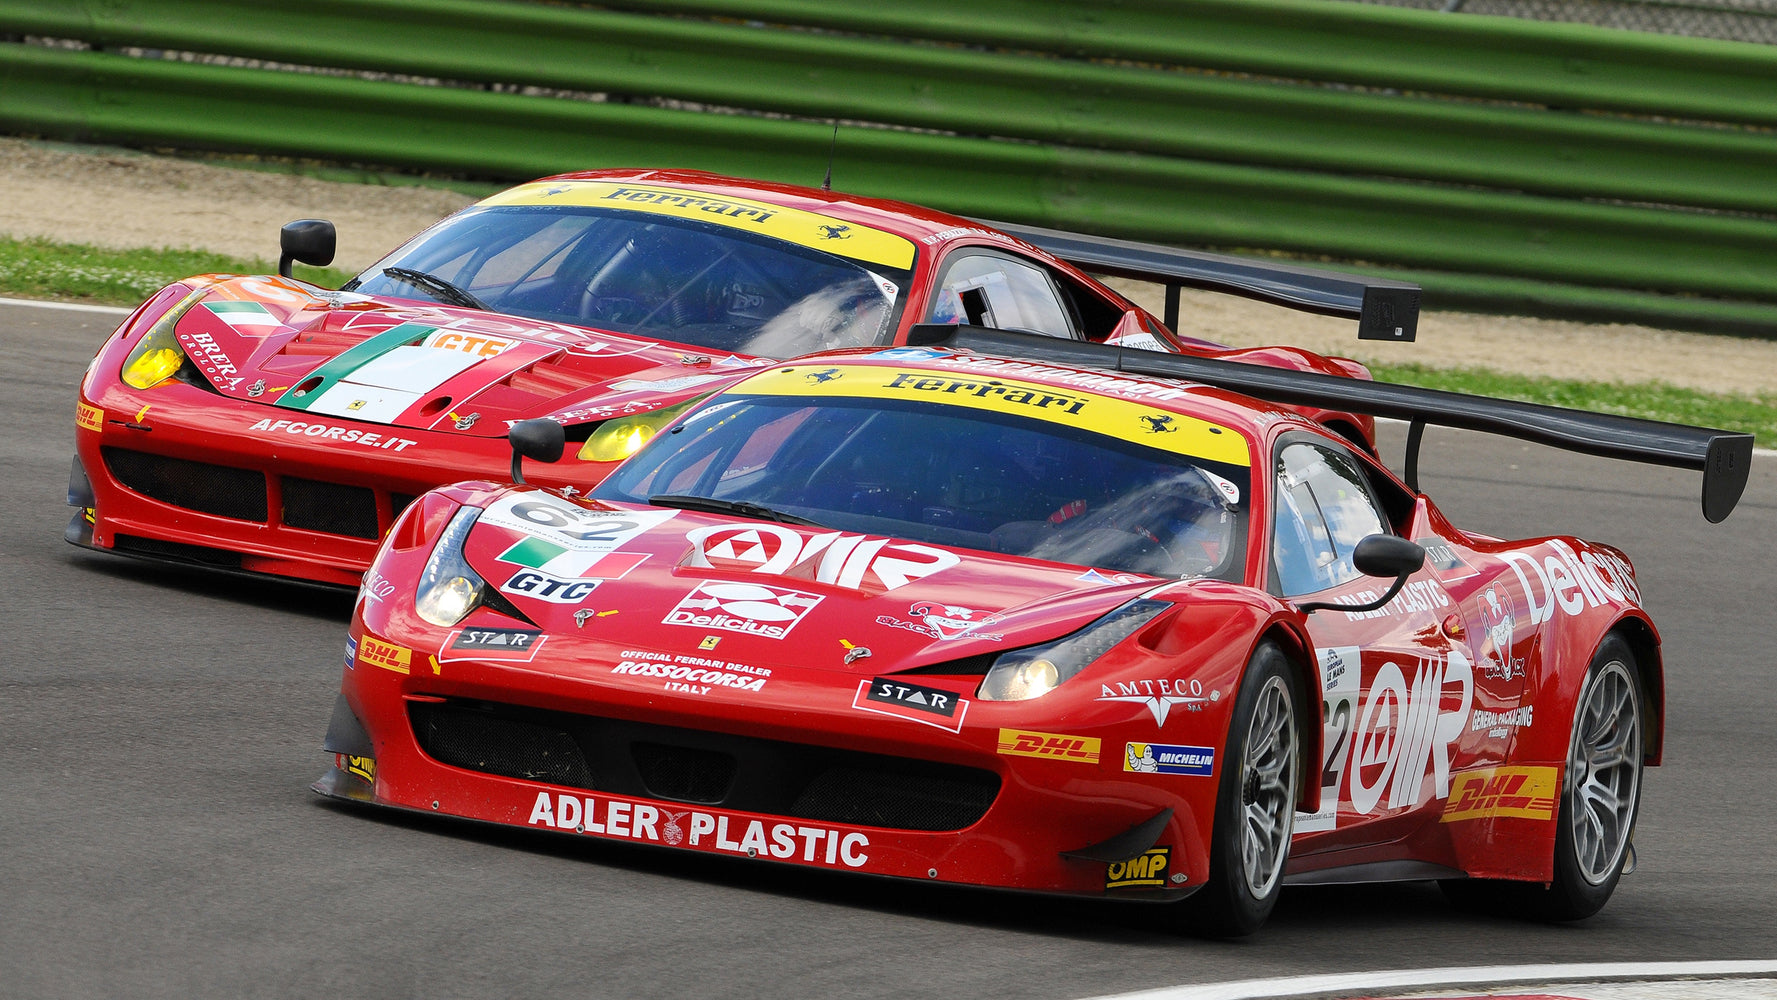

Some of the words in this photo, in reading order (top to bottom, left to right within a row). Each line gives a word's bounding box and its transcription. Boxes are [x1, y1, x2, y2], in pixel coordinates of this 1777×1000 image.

[600, 187, 778, 224] Ferrari
[180, 334, 229, 390] OROLOGI
[191, 331, 246, 388] BRERA
[883, 372, 1090, 416] Ferrari
[248, 417, 418, 452] AFCORSE.IT
[510, 501, 640, 541] 62
[508, 572, 595, 600] GTC
[1384, 578, 1450, 614] PLASTIC
[666, 611, 785, 637] Delicius
[364, 640, 402, 668] DHL
[620, 650, 672, 663] OFFICIAL
[674, 655, 725, 669] FERRARI
[725, 662, 773, 677] DEALER
[611, 660, 767, 692] ROSSOCORSA
[1332, 664, 1346, 679] MANS
[664, 681, 712, 696] ITALY
[1100, 678, 1203, 698] AMTECO
[1471, 708, 1498, 732] GENERAL
[1498, 704, 1534, 728] PACKAGING
[1012, 734, 1090, 758] DHL
[1158, 751, 1214, 766] MICHELIN
[1454, 774, 1534, 813] DHL
[528, 791, 660, 841] ADLER
[689, 811, 871, 868] PLASTIC
[1107, 854, 1168, 880] OMP
